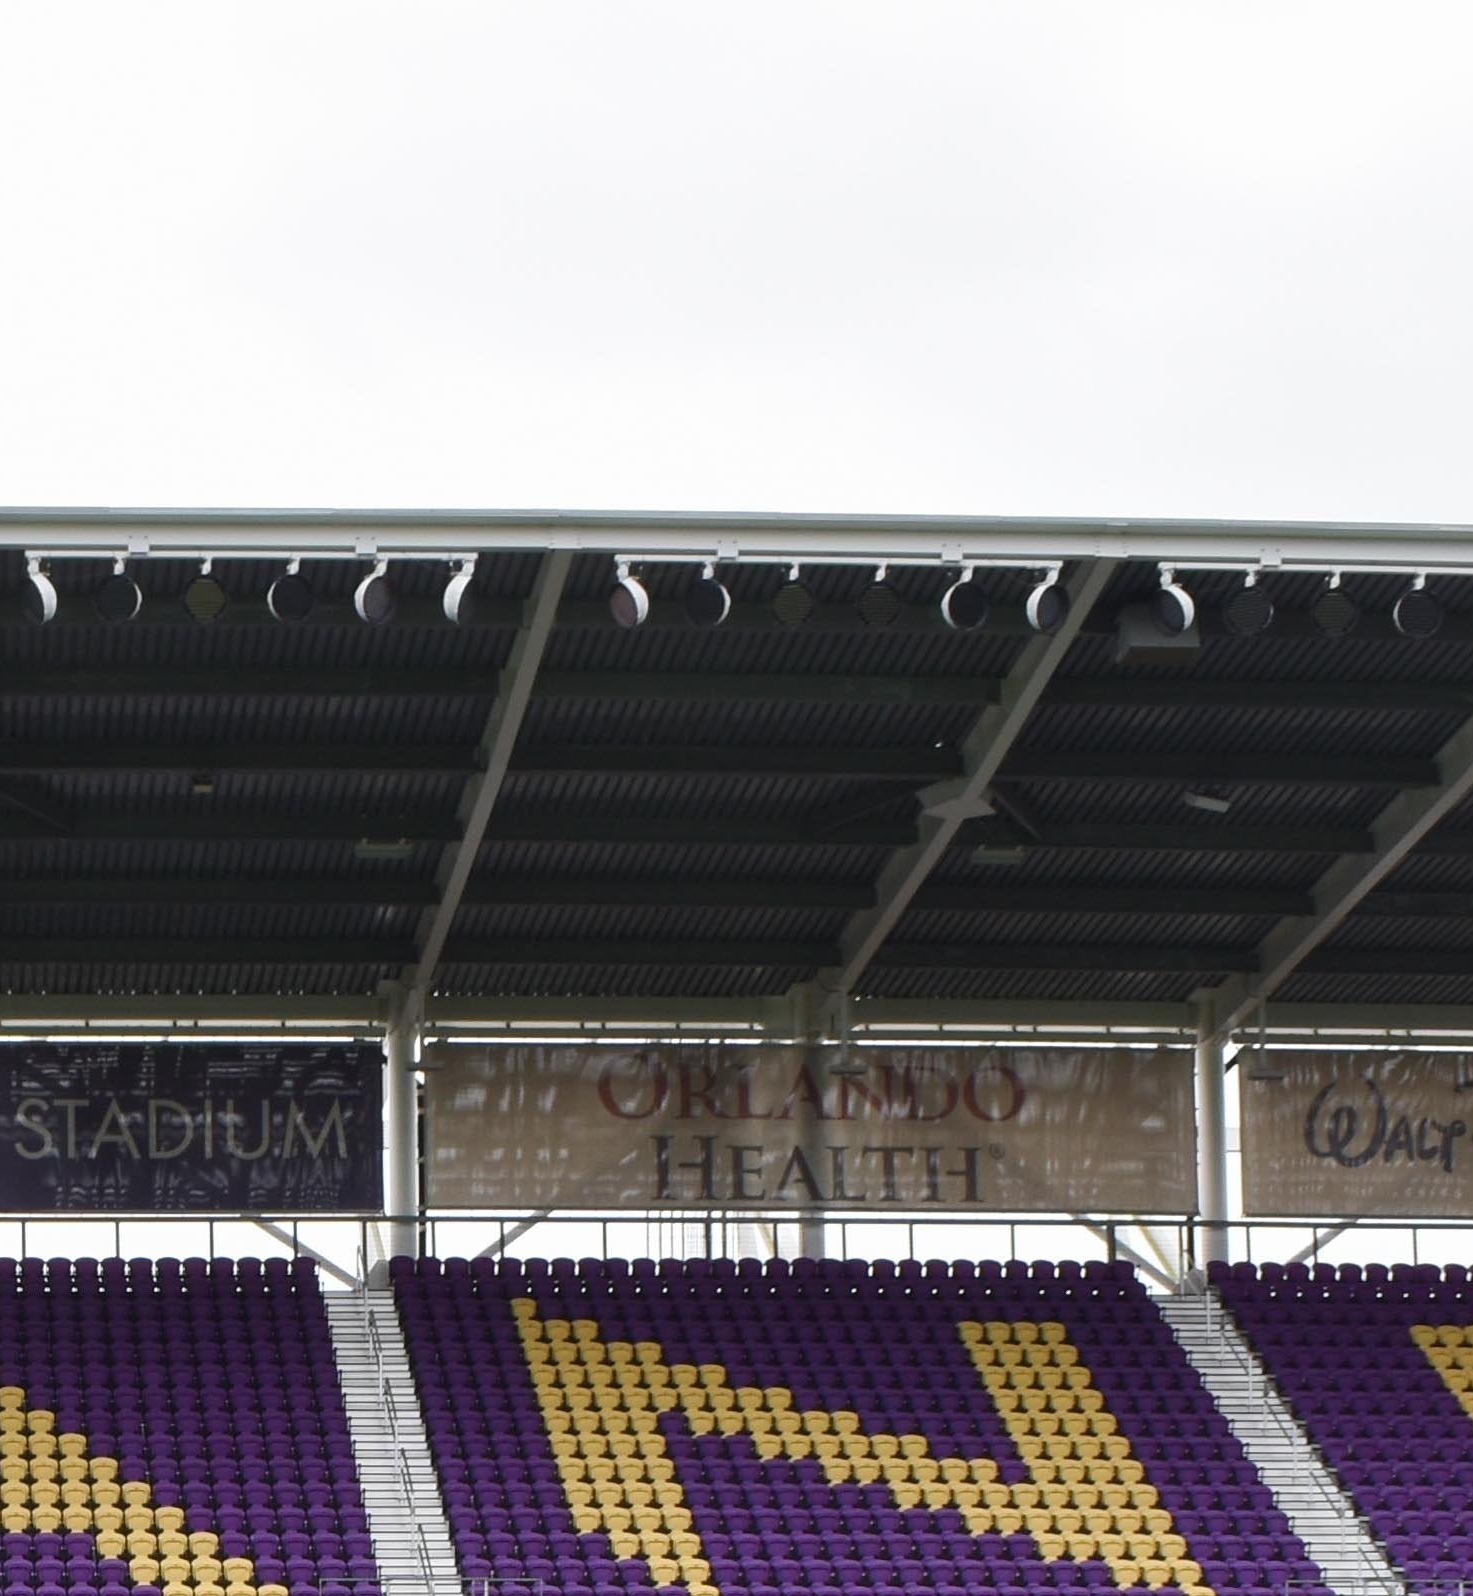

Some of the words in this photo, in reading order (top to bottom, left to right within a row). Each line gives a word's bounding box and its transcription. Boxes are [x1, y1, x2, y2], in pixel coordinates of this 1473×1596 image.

[597, 1056, 1027, 1123] ORLANDO
[15, 1097, 349, 1162] STADIUM
[652, 1135, 985, 1204] HEALTH
